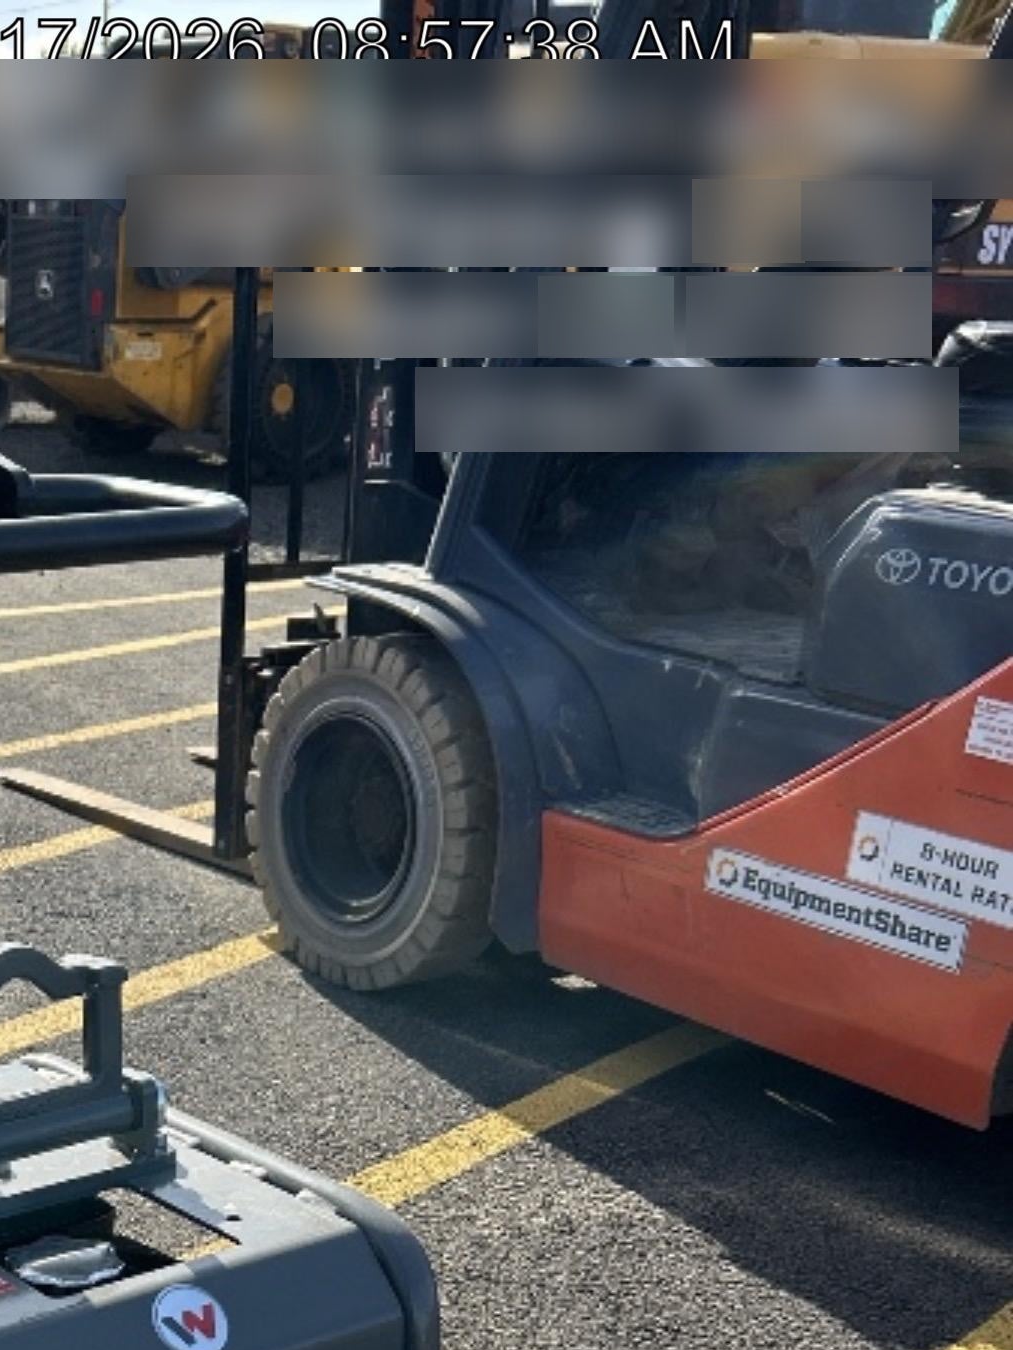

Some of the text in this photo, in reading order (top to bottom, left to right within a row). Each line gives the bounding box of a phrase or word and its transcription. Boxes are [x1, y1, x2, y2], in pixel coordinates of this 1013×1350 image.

[920, 841, 999, 880] 8-HOUR
[742, 866, 951, 952] EquipmentShare
[890, 861, 1013, 915] RENTAL RAT
